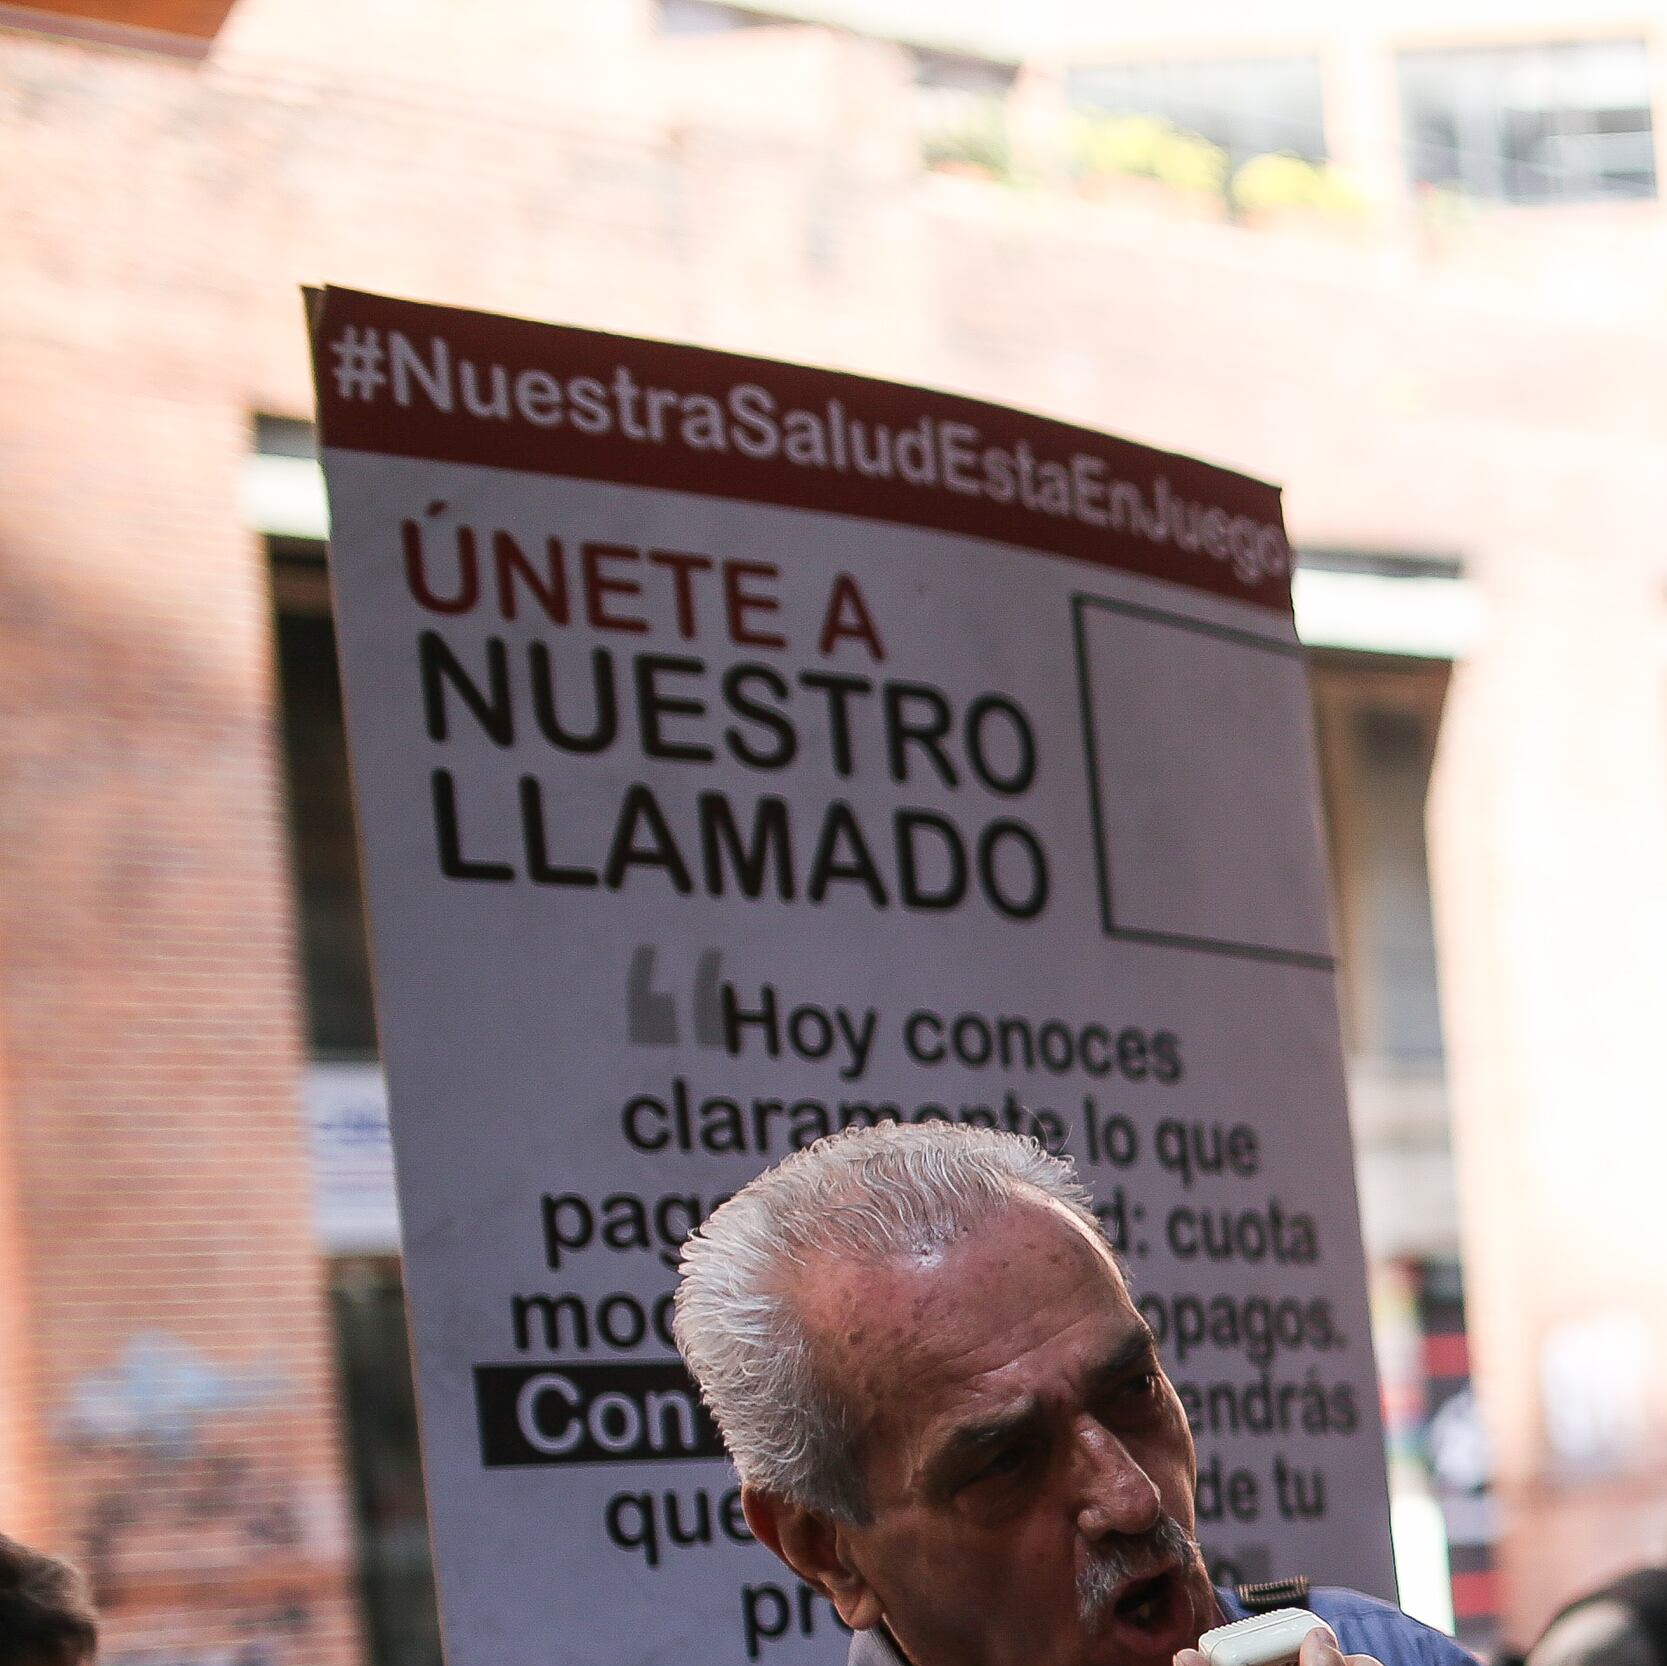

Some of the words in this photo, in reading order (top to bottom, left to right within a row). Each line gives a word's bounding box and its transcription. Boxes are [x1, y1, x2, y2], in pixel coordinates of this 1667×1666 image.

[332, 328, 1290, 584] #NuestraSaludEstaEnJuego
[405, 503, 787, 649] ÚNETE
[818, 573, 884, 662] A
[420, 630, 1035, 795] NUESTRO
[433, 770, 1050, 921] LLAMADO
[903, 996, 1185, 1084] conoces
[1083, 1096, 1138, 1172] lo
[1153, 1115, 1260, 1188] que
[1165, 1197, 1319, 1266] cuota
[1138, 1291, 1348, 1368] opagos.
[515, 1372, 698, 1456] Con
[1178, 1368, 1359, 1438] endrás
[604, 1488, 752, 1569] que
[1274, 1455, 1328, 1521] tu
